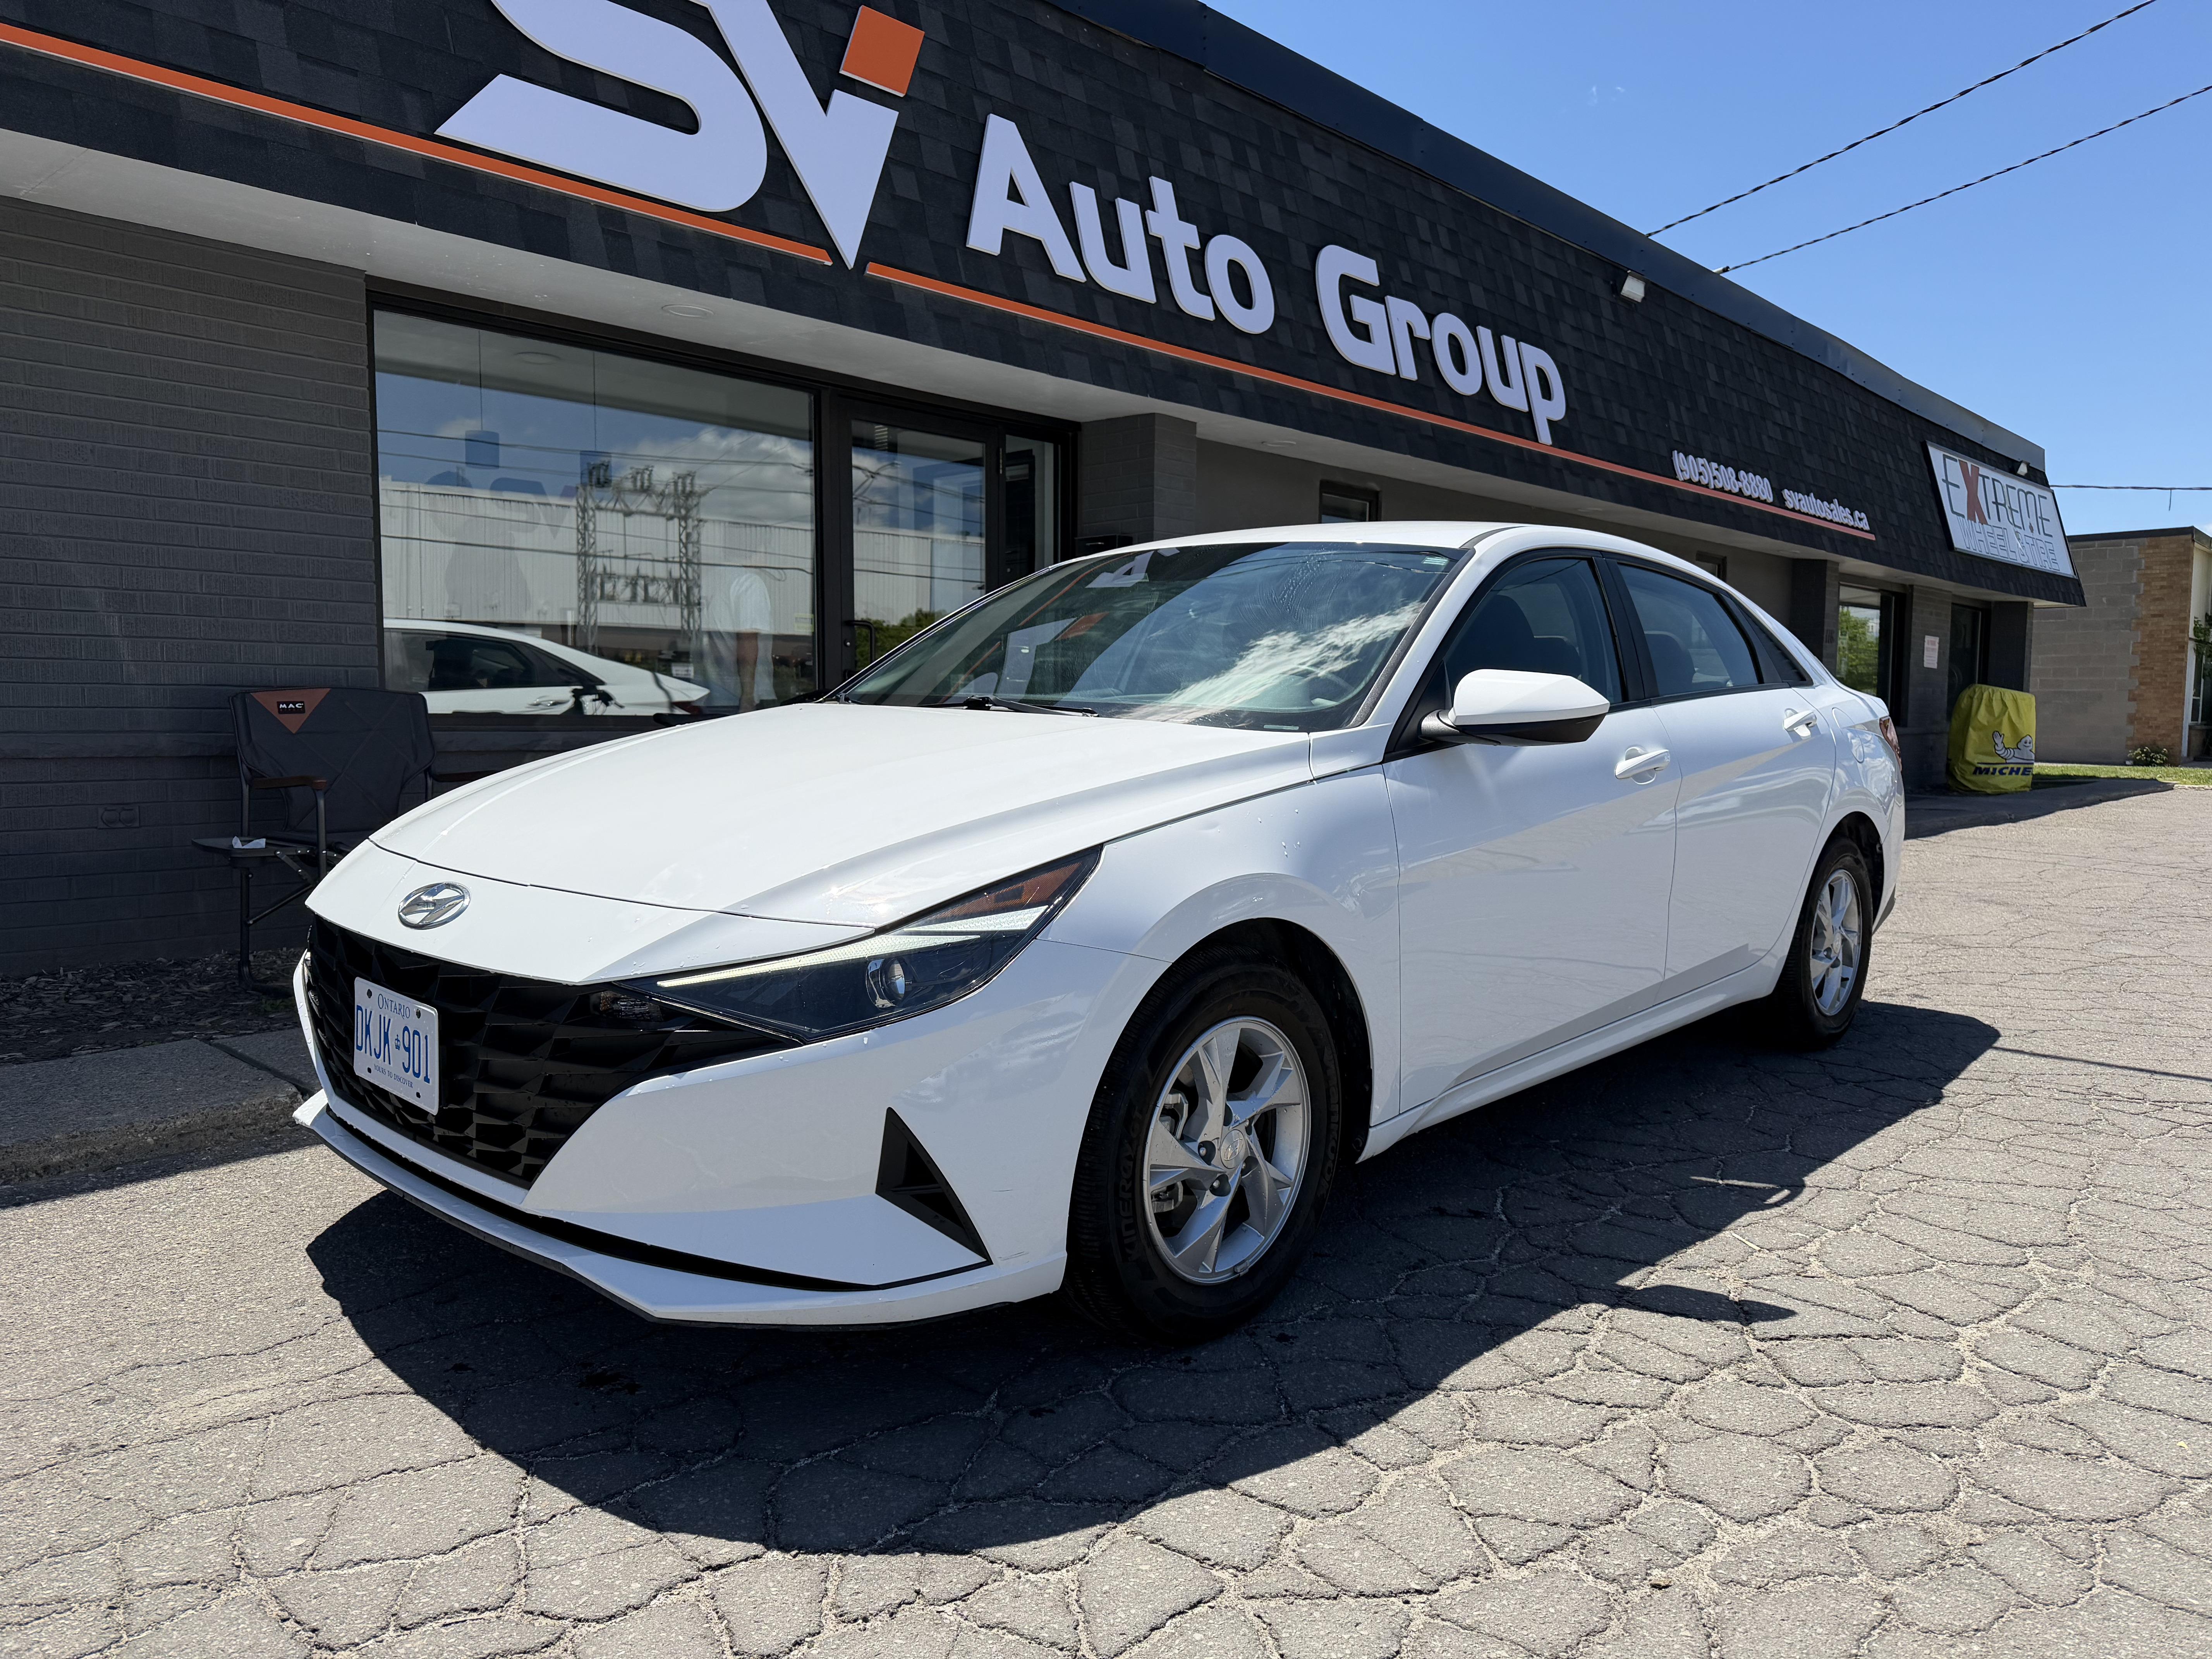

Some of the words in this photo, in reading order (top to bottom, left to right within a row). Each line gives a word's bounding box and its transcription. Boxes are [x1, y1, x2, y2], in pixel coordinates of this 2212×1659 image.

[965, 113, 1275, 334] Auto
[1315, 244, 1566, 444] Group
[1672, 450, 1773, 503] (905)508-8880
[1781, 489, 1870, 531] svautosales.ca
[1942, 454, 2052, 538] EXTREME
[1973, 766, 2033, 776] MICHE
[356, 1005, 391, 1065] DKJK
[402, 1026, 430, 1084] 901
[378, 994, 410, 1019] ONTARIO
[374, 1063, 386, 1075] YOURS
[394, 1073, 413, 1088] DISCOVER
